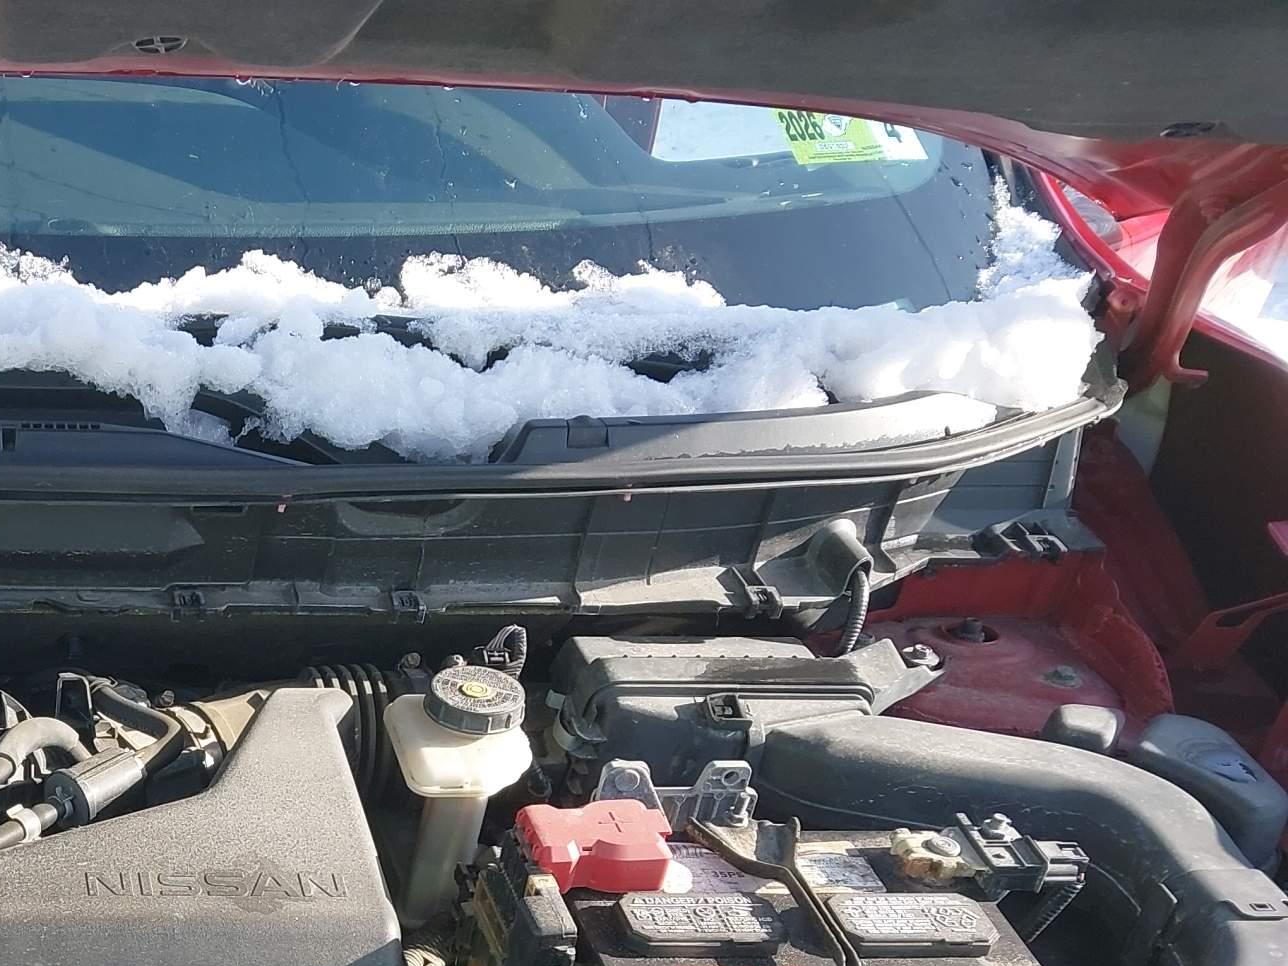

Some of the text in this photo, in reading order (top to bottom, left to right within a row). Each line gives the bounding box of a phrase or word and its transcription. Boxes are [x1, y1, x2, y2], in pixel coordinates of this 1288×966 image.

[84, 871, 349, 898] NISSAN
[645, 896, 697, 904] DANGER
[708, 896, 753, 904] POISON
